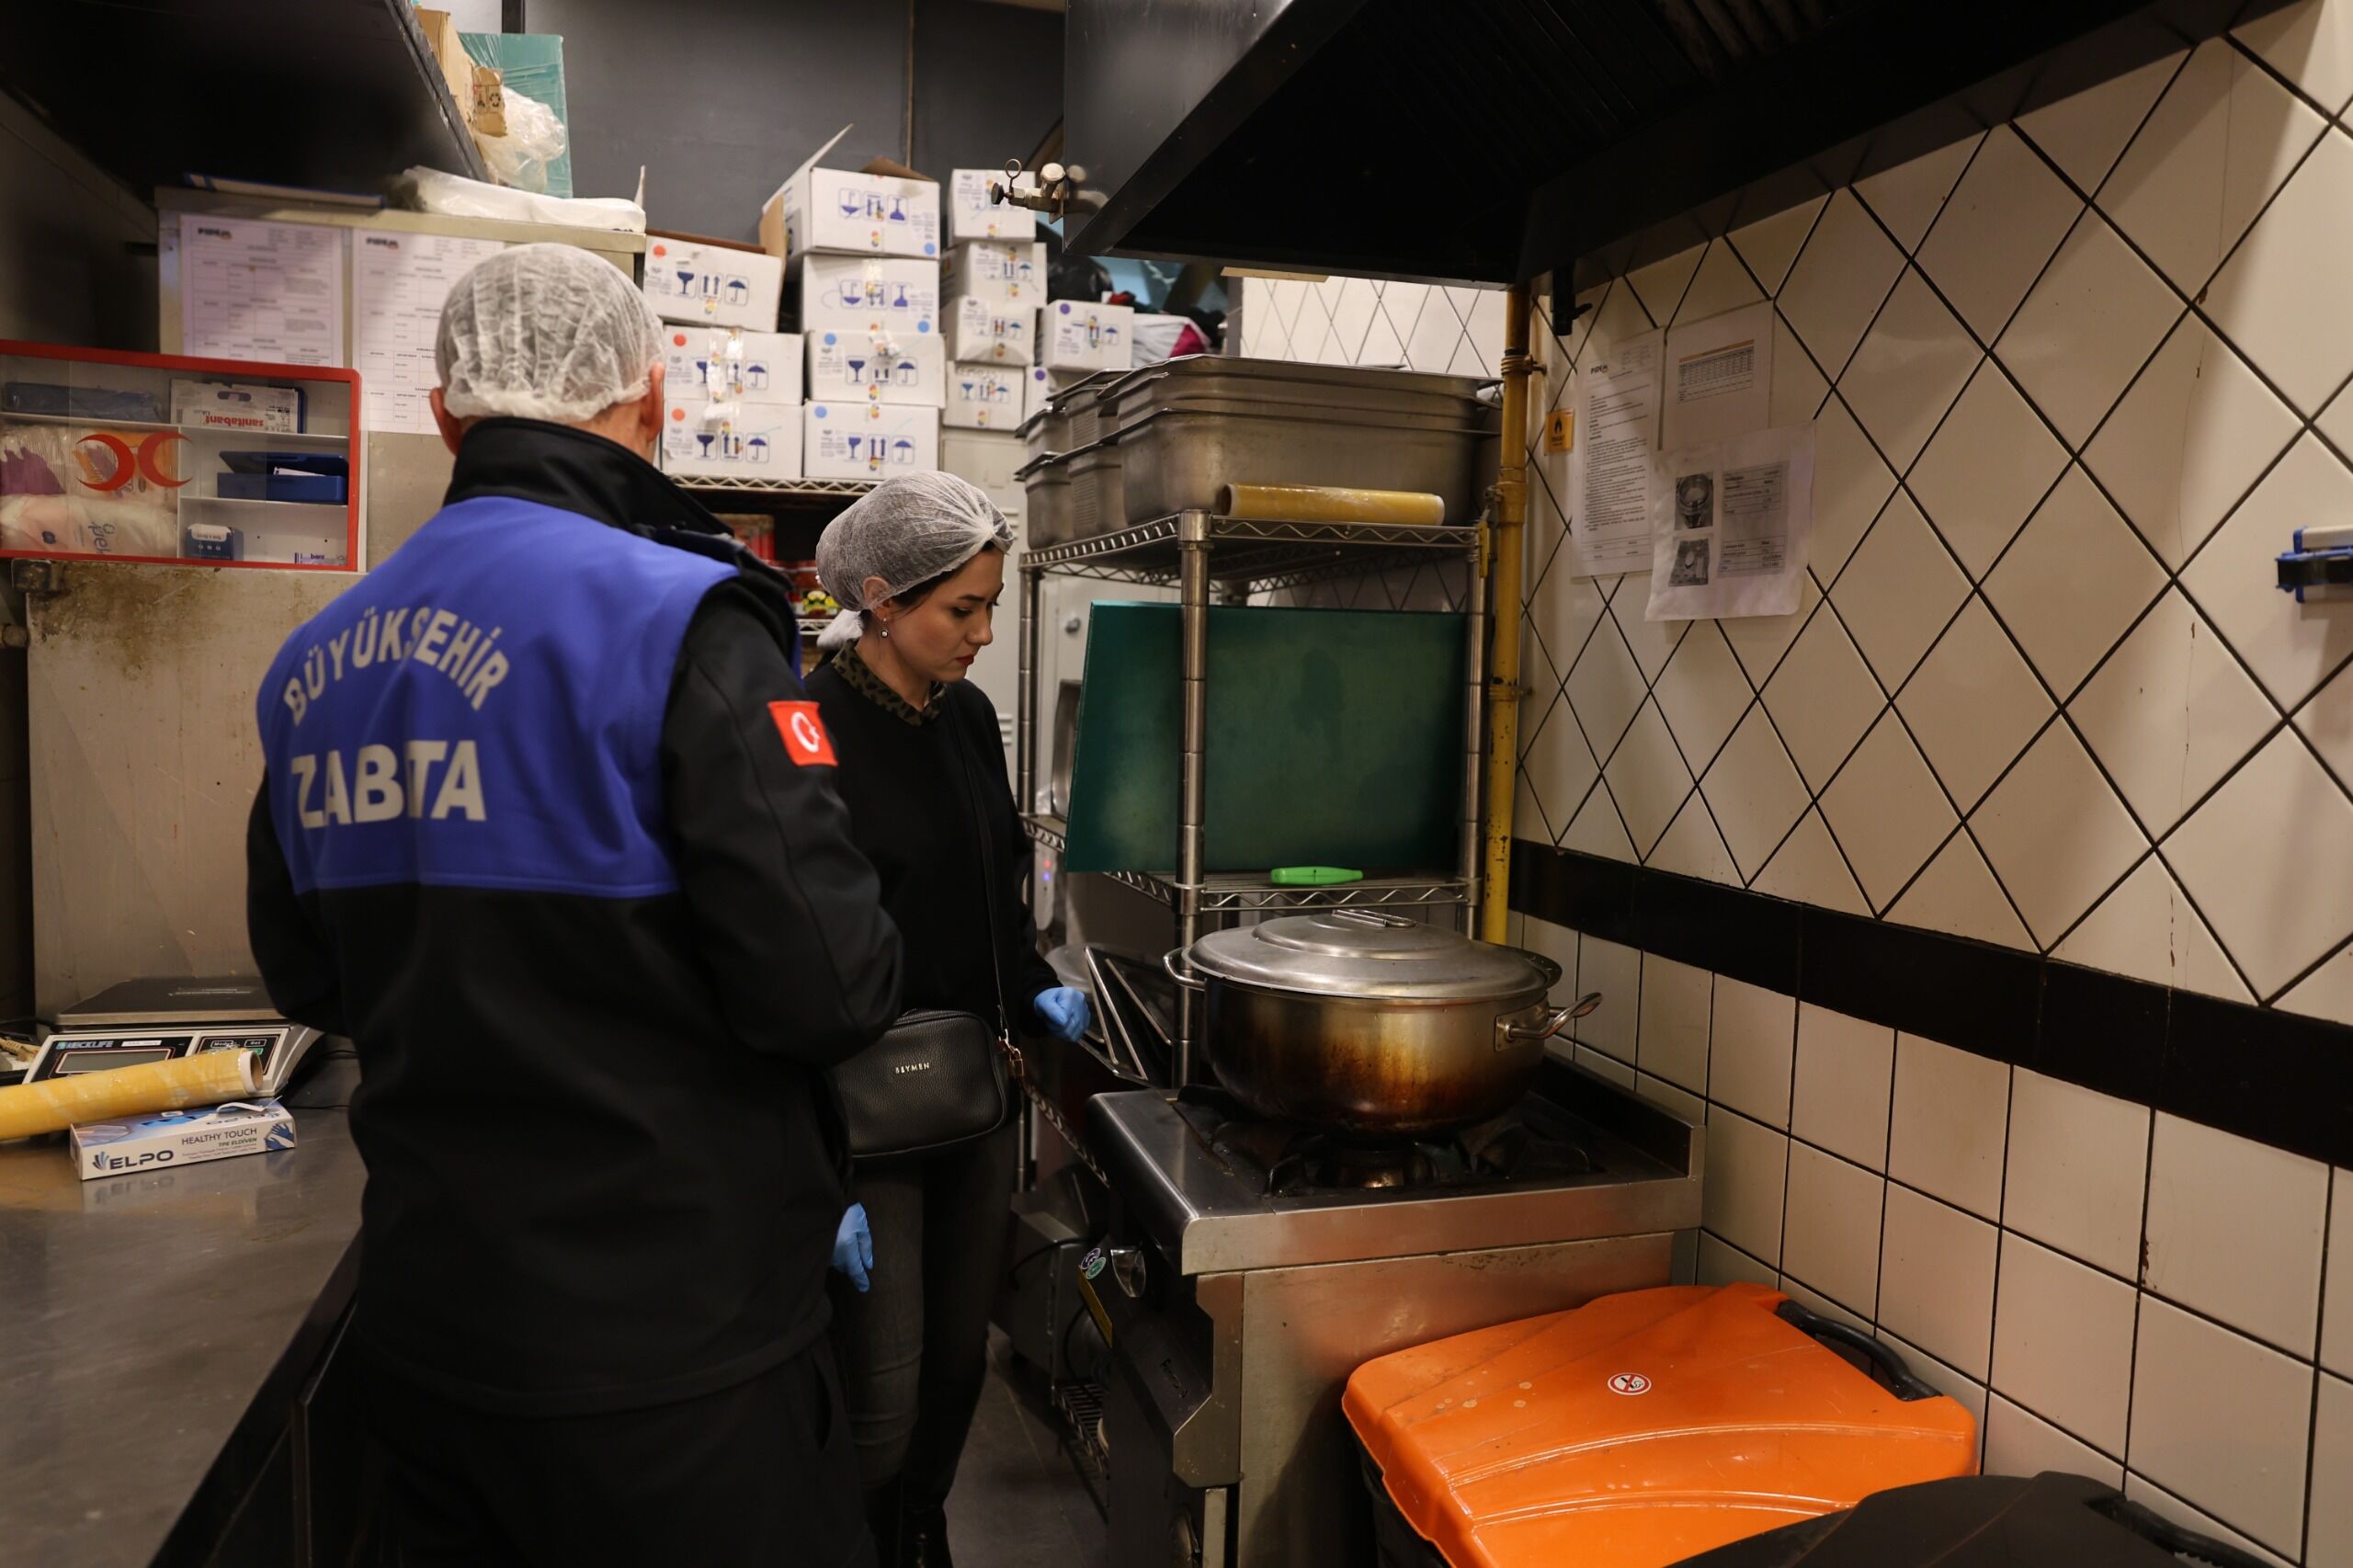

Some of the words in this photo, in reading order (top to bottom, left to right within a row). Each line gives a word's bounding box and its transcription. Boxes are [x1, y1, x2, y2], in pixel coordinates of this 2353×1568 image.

[283, 606, 510, 726] BÜYÜKŞEHİR
[181, 1132, 222, 1146] HEALTHY
[224, 1128, 257, 1139] TOUCH
[109, 1150, 174, 1170] ELPO
